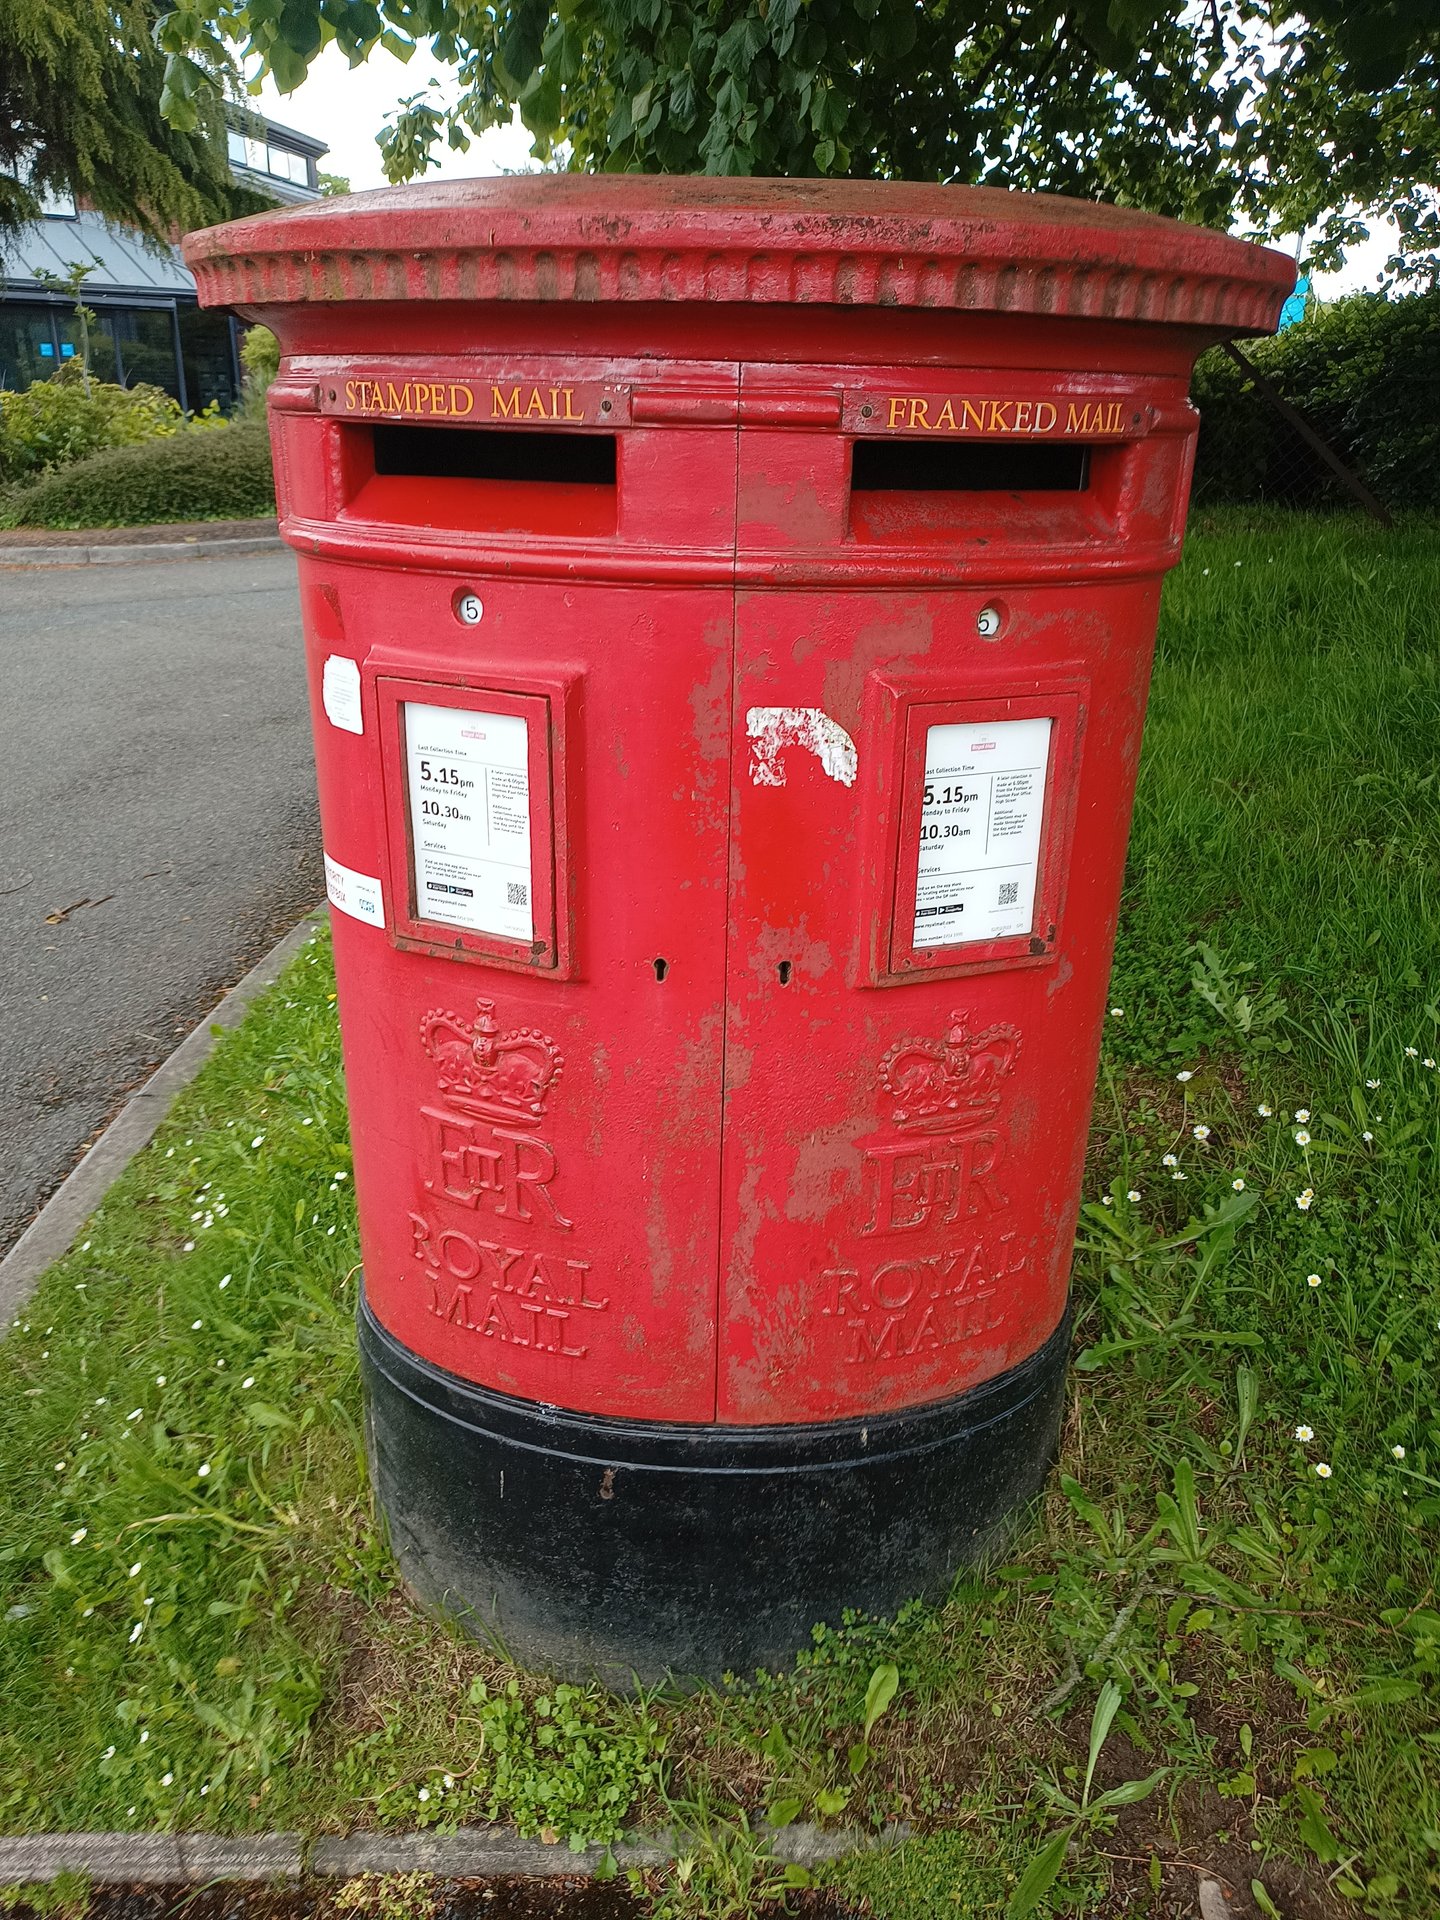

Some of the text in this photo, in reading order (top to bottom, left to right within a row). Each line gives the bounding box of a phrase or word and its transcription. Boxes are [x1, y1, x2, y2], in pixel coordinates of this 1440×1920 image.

[345, 380, 585, 421] STAMPED MAIL
[886, 397, 1125, 433] FRANKED MAIL
[466, 599, 478, 620] 5
[979, 612, 989, 632] 5
[421, 761, 474, 788] 5.15pm
[936, 765, 961, 774] Collection
[421, 785, 441, 795] Monday
[450, 789, 468, 798] Friday
[923, 784, 979, 806] 5.15pm
[421, 800, 472, 822] 10.30am
[952, 806, 970, 814] Friday
[423, 818, 447, 829] Saturday
[919, 824, 971, 840] 10.30am
[424, 841, 447, 850] Services
[408, 1212, 610, 1309] ROYAL
[822, 1231, 1027, 1315] ROYAL
[425, 1269, 589, 1358] MAIL
[845, 1288, 1006, 1363] MAIL
